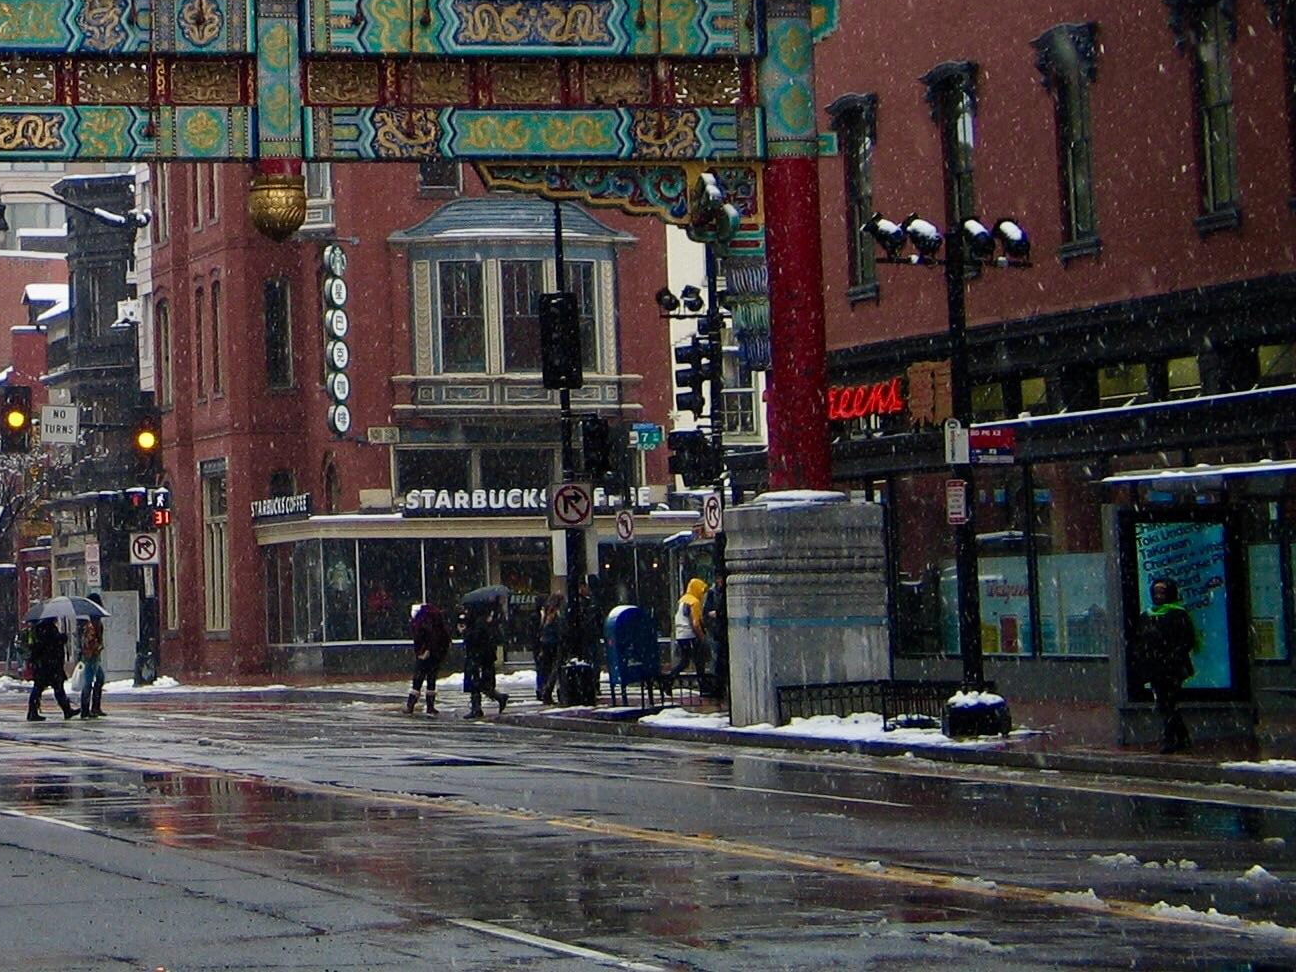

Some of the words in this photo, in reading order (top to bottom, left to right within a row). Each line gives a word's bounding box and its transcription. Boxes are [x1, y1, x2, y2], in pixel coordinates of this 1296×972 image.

[53, 409, 66, 419] NO
[45, 424, 74, 435] TURNS
[250, 495, 286, 517] STARBUCKS
[285, 492, 307, 514] COFFEE
[154, 511, 169, 524] 31
